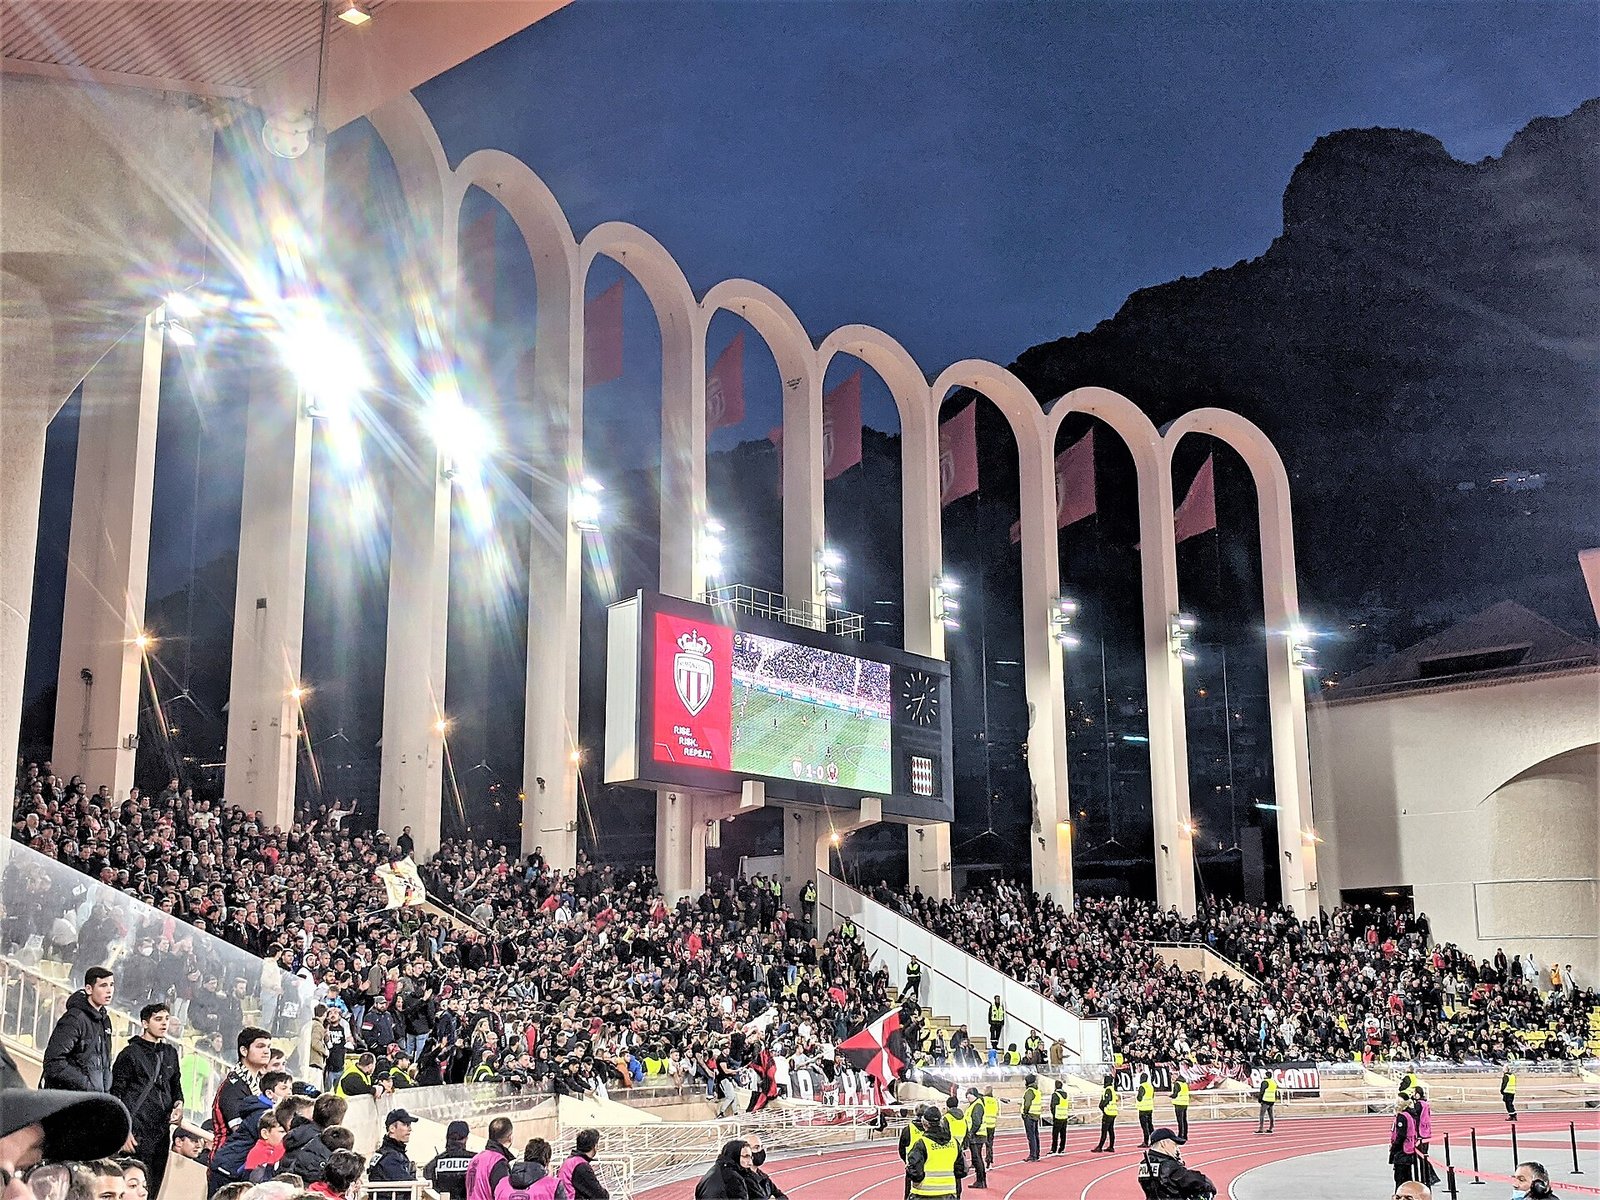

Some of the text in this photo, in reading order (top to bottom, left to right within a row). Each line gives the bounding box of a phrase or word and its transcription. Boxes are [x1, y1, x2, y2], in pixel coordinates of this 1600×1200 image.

[673, 725, 692, 737] RISE.
[678, 736, 698, 747] RISK.
[683, 747, 712, 760] REPEAT.
[439, 1160, 468, 1169] POLIC
